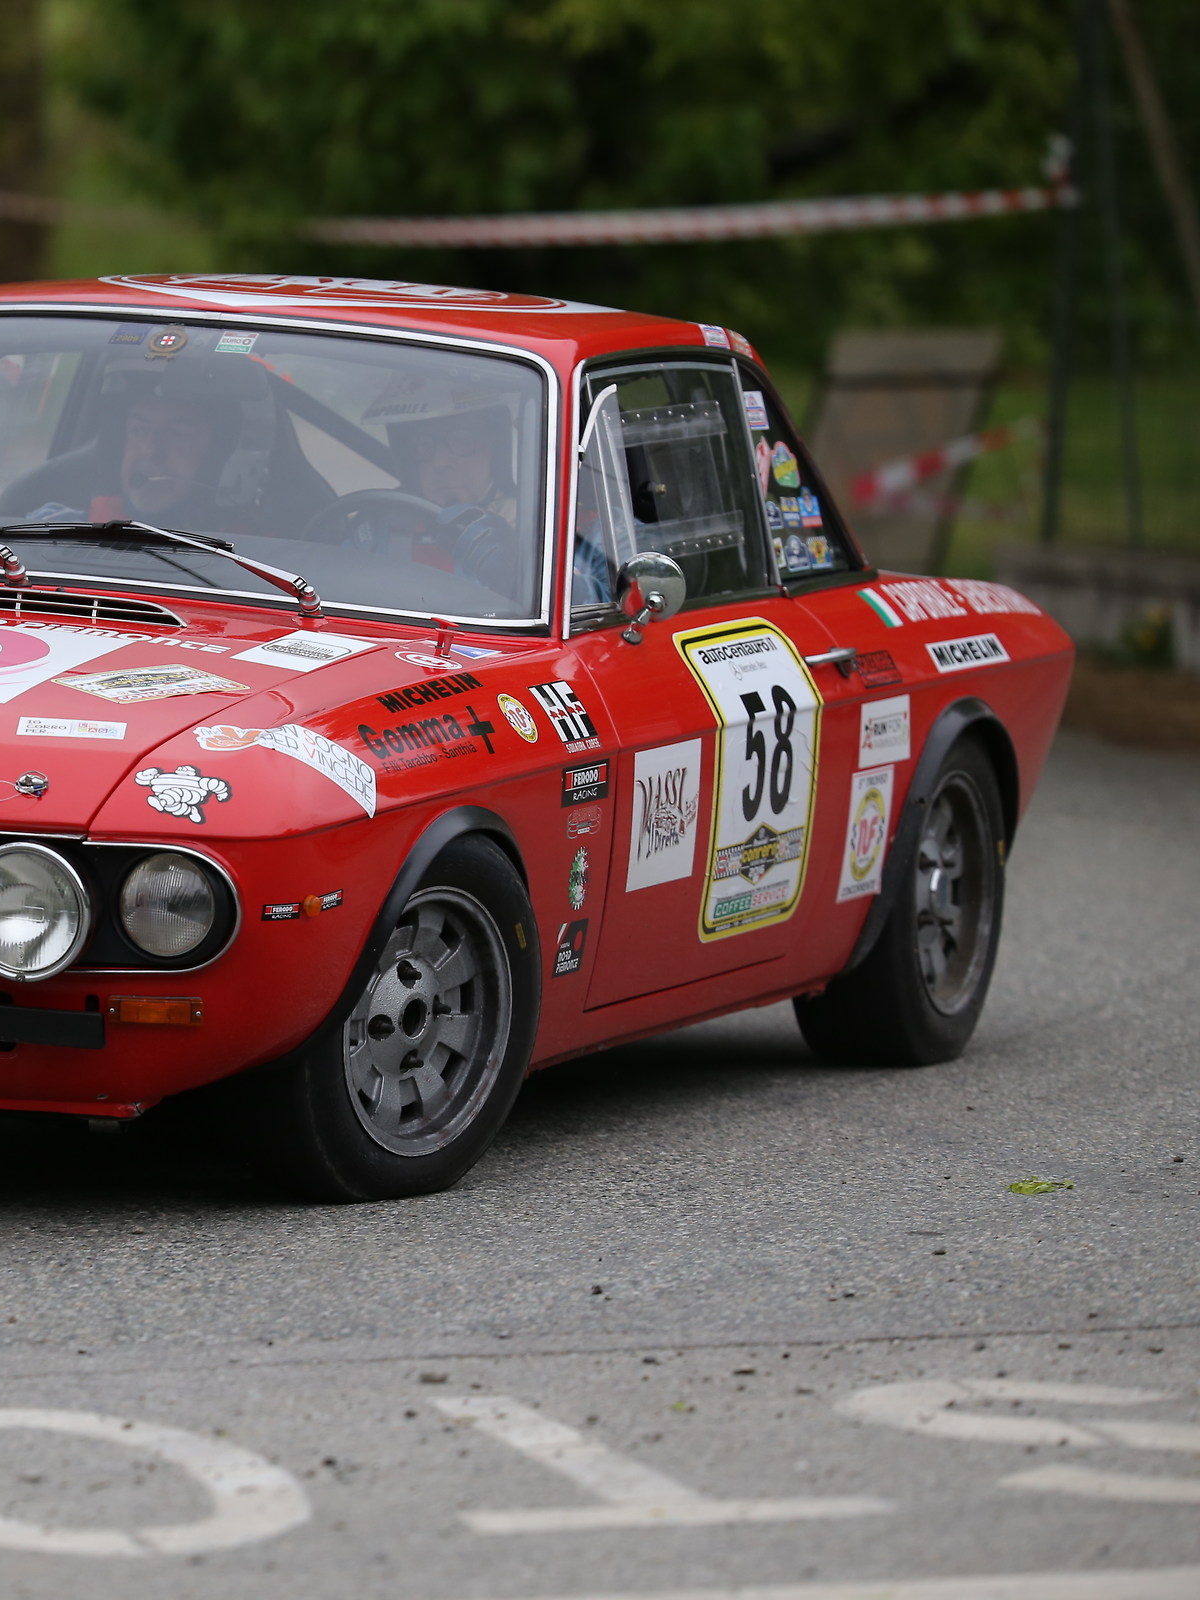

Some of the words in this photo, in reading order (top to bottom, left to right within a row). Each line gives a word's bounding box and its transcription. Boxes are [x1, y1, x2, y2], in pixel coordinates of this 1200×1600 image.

[932, 636, 1004, 668] MICHELIN
[376, 672, 484, 713] MICHELIN
[528, 681, 590, 742] HF
[303, 729, 373, 784] SOGNO
[399, 753, 438, 770] Tarabbo
[739, 684, 797, 822] 58
[573, 769, 599, 786] FERODO
[572, 787, 598, 801] RACING
[272, 905, 293, 913] FERODO
